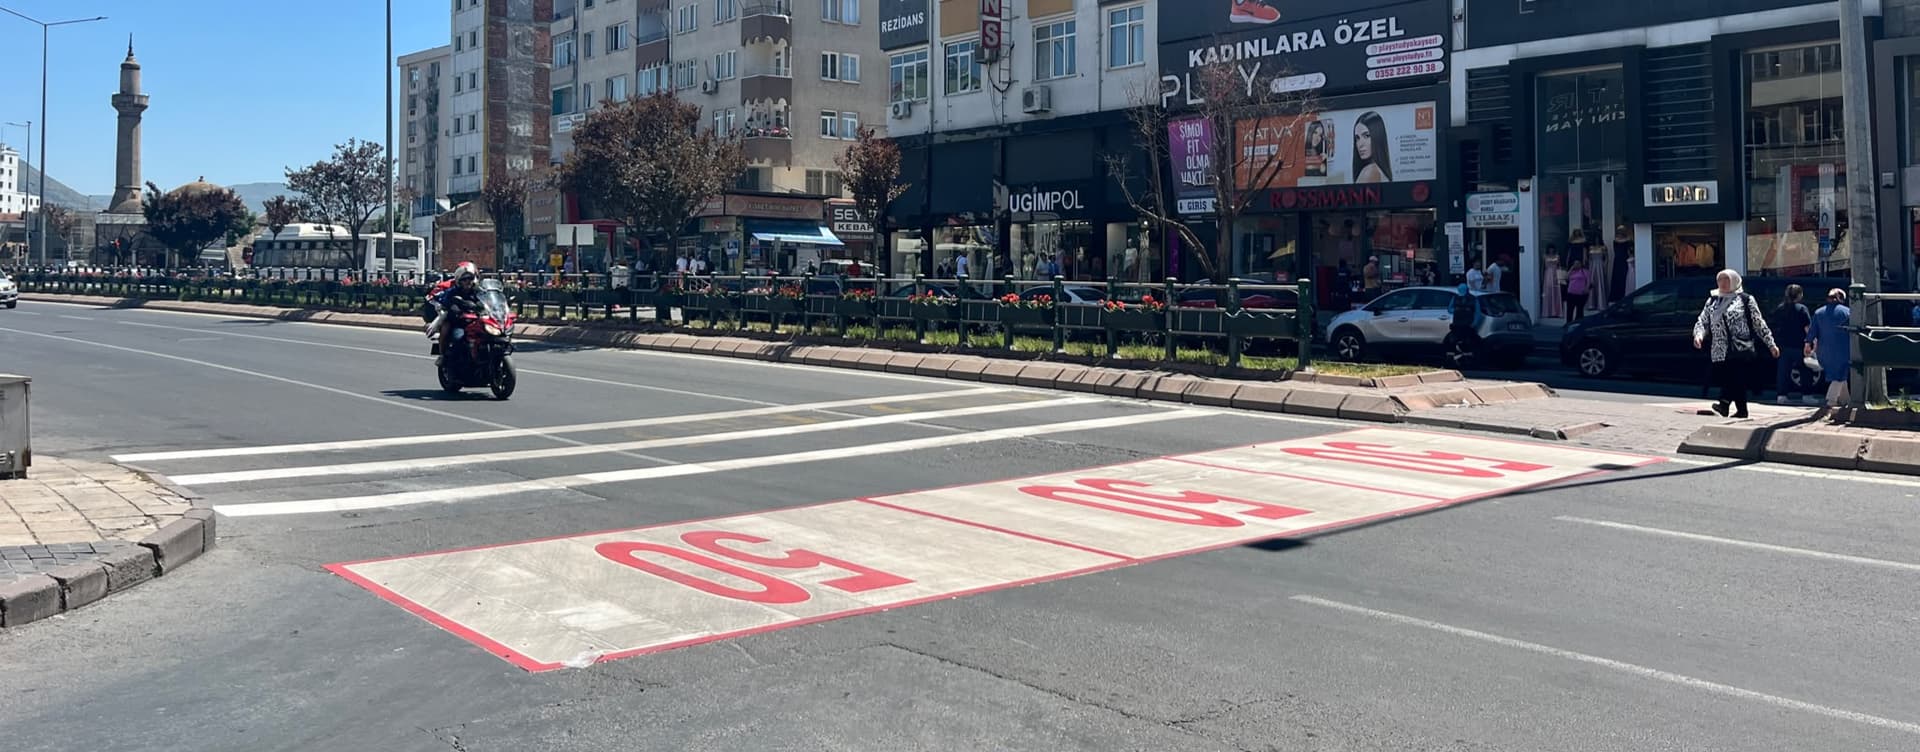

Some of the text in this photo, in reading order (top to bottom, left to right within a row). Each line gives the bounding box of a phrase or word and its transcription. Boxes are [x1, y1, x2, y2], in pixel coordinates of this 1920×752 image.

[881, 12, 924, 33] REZİDANS
[1188, 16, 1405, 68] KADINLARA ÖZEL
[1375, 63, 1436, 79] 0352 222 90 38
[1186, 154, 1211, 170] OLMA
[1270, 186, 1382, 208] ROSSMANN
[1472, 214, 1511, 222] YILMAZ
[1280, 441, 1553, 478] 50
[1017, 478, 1313, 528] 50
[594, 530, 917, 605] 50
